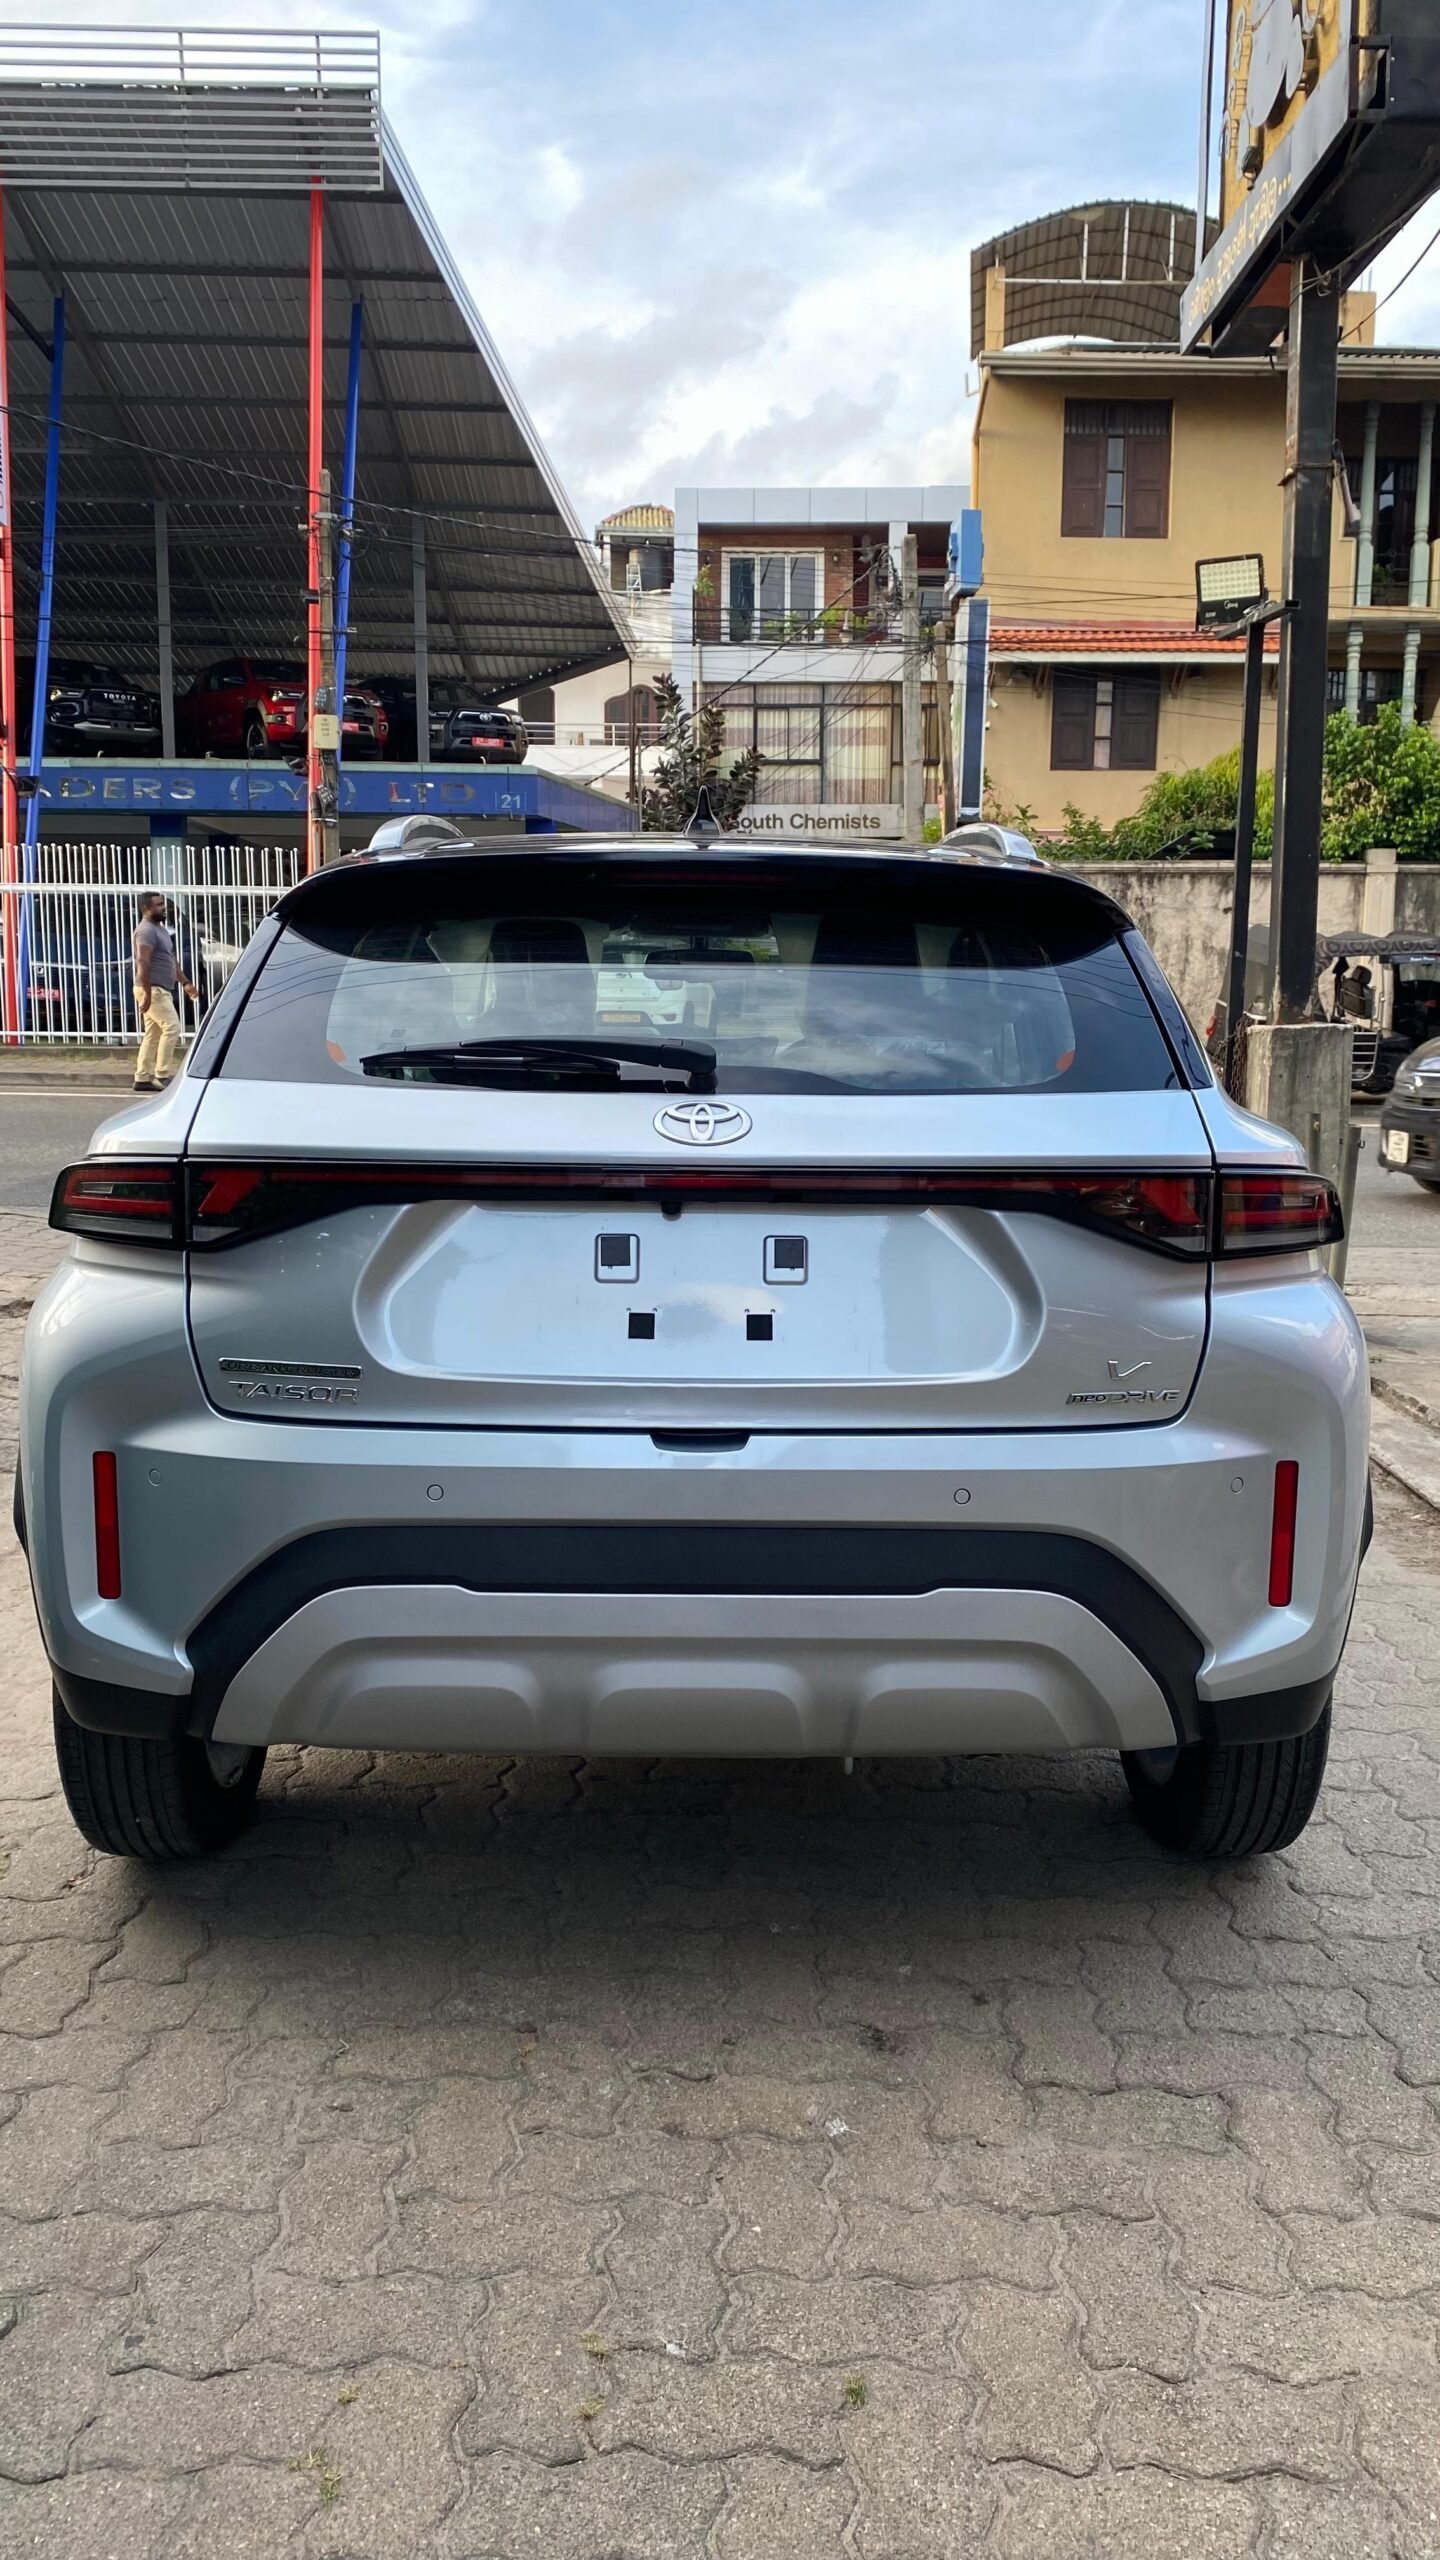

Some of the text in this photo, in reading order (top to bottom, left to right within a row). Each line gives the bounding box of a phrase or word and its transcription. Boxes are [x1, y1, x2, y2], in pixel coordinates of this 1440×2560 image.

[103, 692, 137, 701] TOYOTA
[389, 782, 476, 805] LTD
[500, 793, 521, 809] 21
[789, 813, 881, 829] Chemists
[226, 1360, 356, 1378] URBAN CRUISER
[1107, 1360, 1153, 1380] V
[228, 1380, 360, 1404] TAISOR
